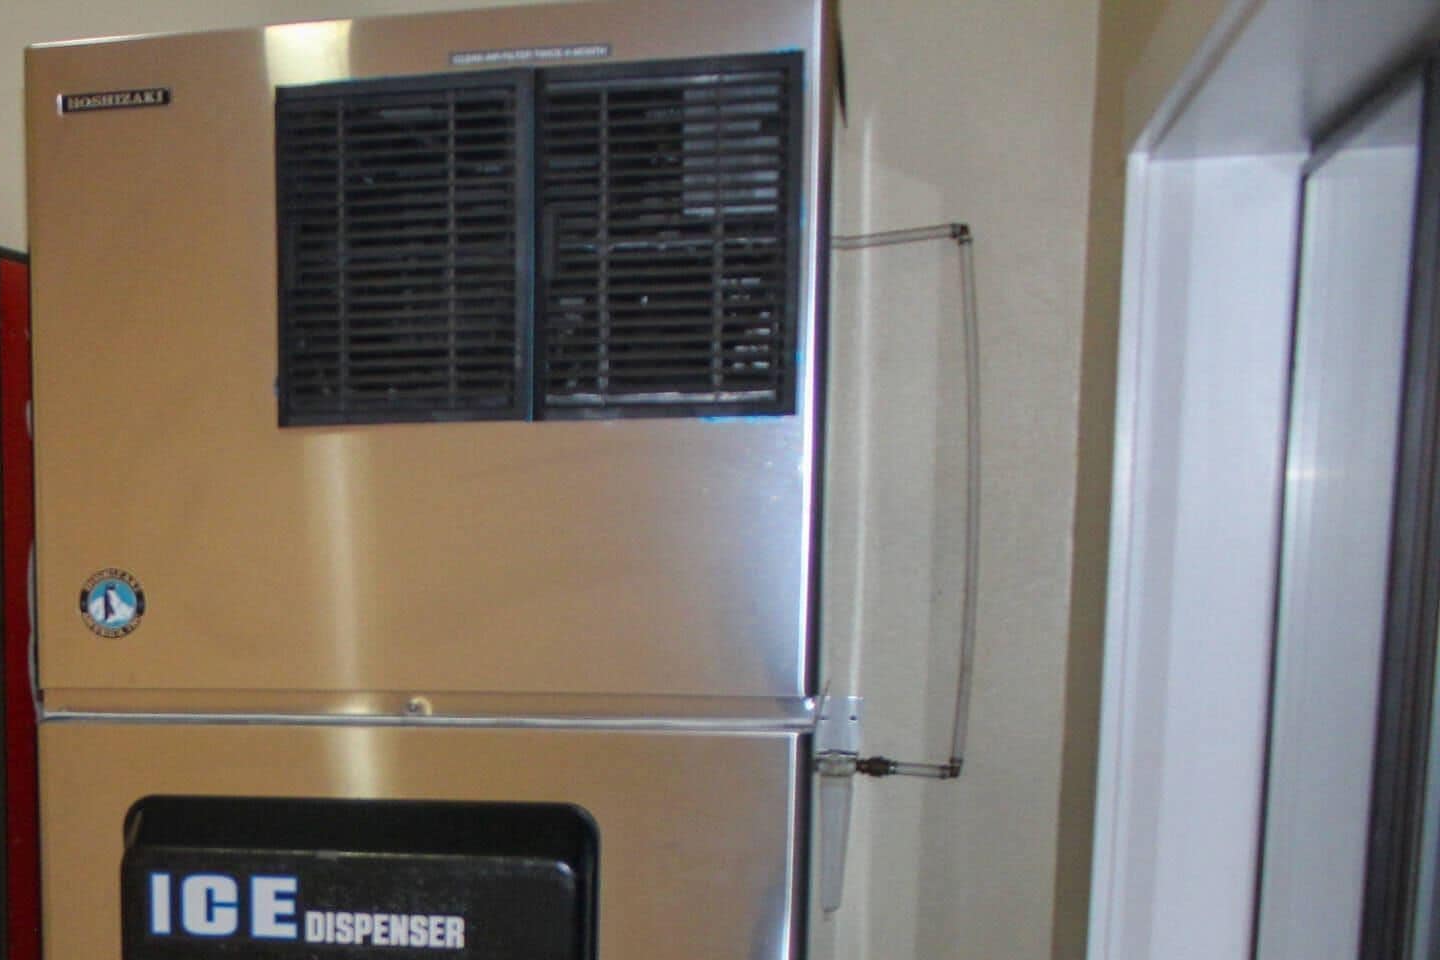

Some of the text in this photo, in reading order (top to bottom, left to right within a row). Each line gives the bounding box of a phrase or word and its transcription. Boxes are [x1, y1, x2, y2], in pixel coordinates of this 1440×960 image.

[66, 90, 164, 111] HOSHIZAKI
[150, 872, 465, 949] ICE DISPENSER
